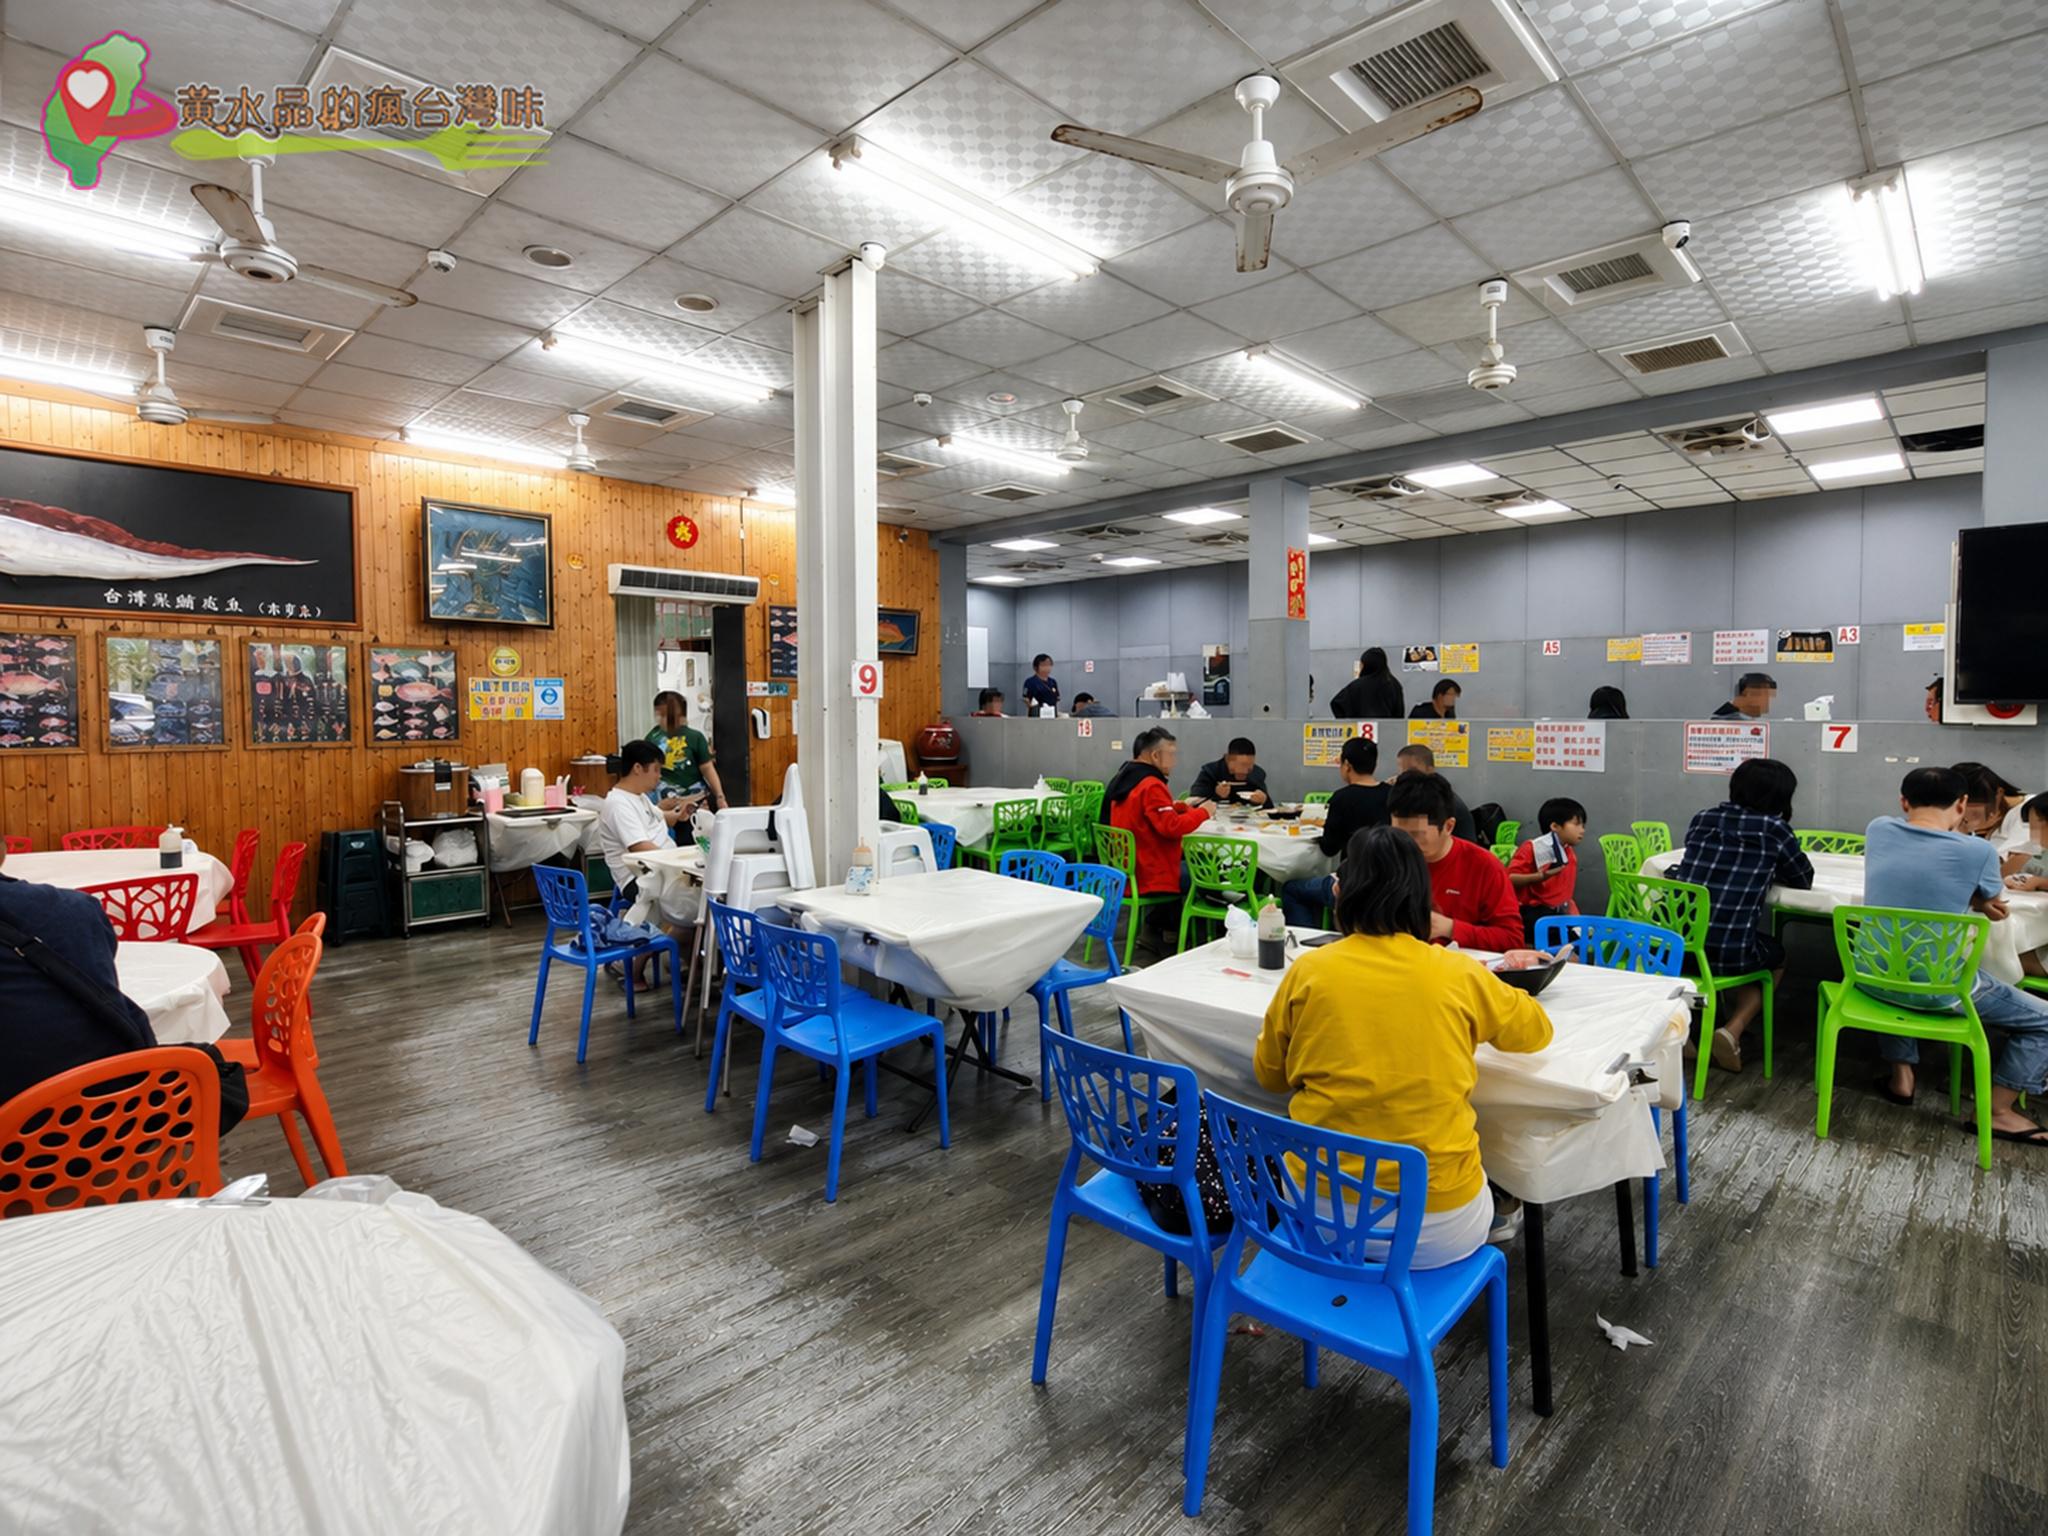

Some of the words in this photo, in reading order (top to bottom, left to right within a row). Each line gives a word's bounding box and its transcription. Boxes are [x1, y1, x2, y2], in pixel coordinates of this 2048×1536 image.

[1839, 627, 1858, 642] A3
[1544, 641, 1560, 654] A5
[859, 664, 877, 695] 9
[1362, 723, 1374, 741] 8
[1828, 726, 1852, 749] 7
